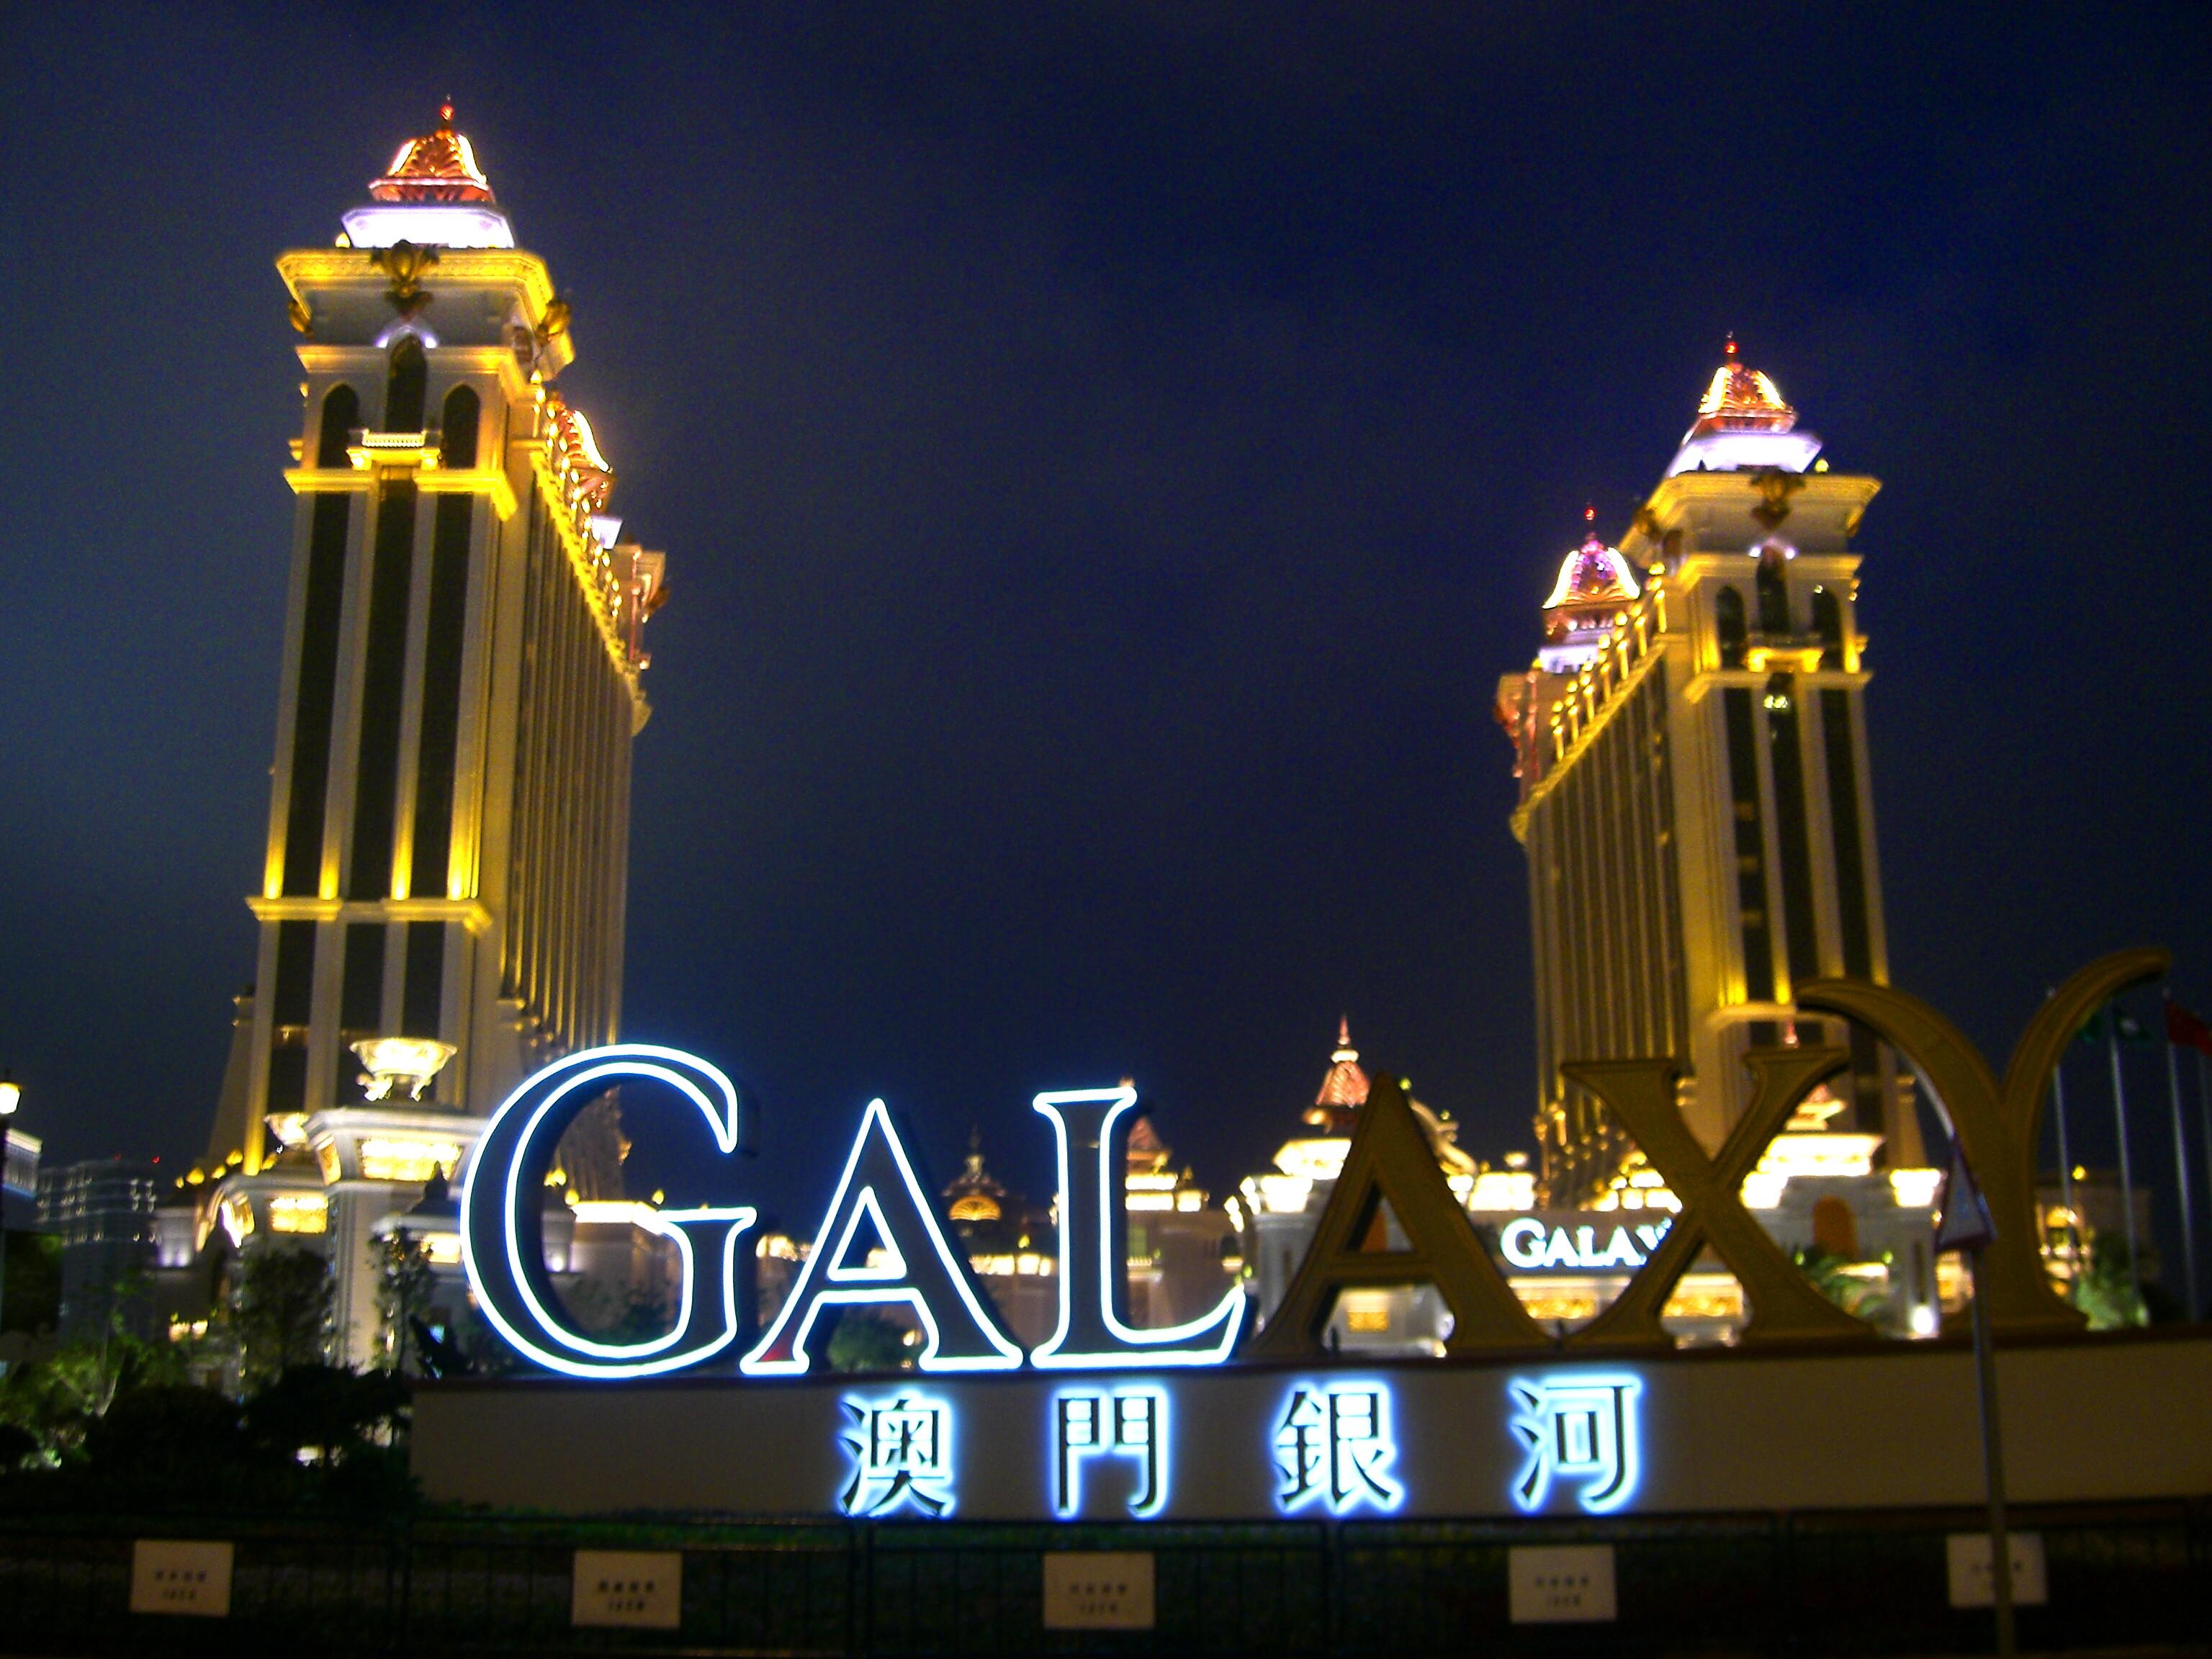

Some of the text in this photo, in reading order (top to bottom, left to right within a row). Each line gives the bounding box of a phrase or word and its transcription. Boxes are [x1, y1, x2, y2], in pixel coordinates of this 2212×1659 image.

[459, 948, 2170, 1380] GALAXY
[837, 1378, 1643, 1519] 澳門銀河
